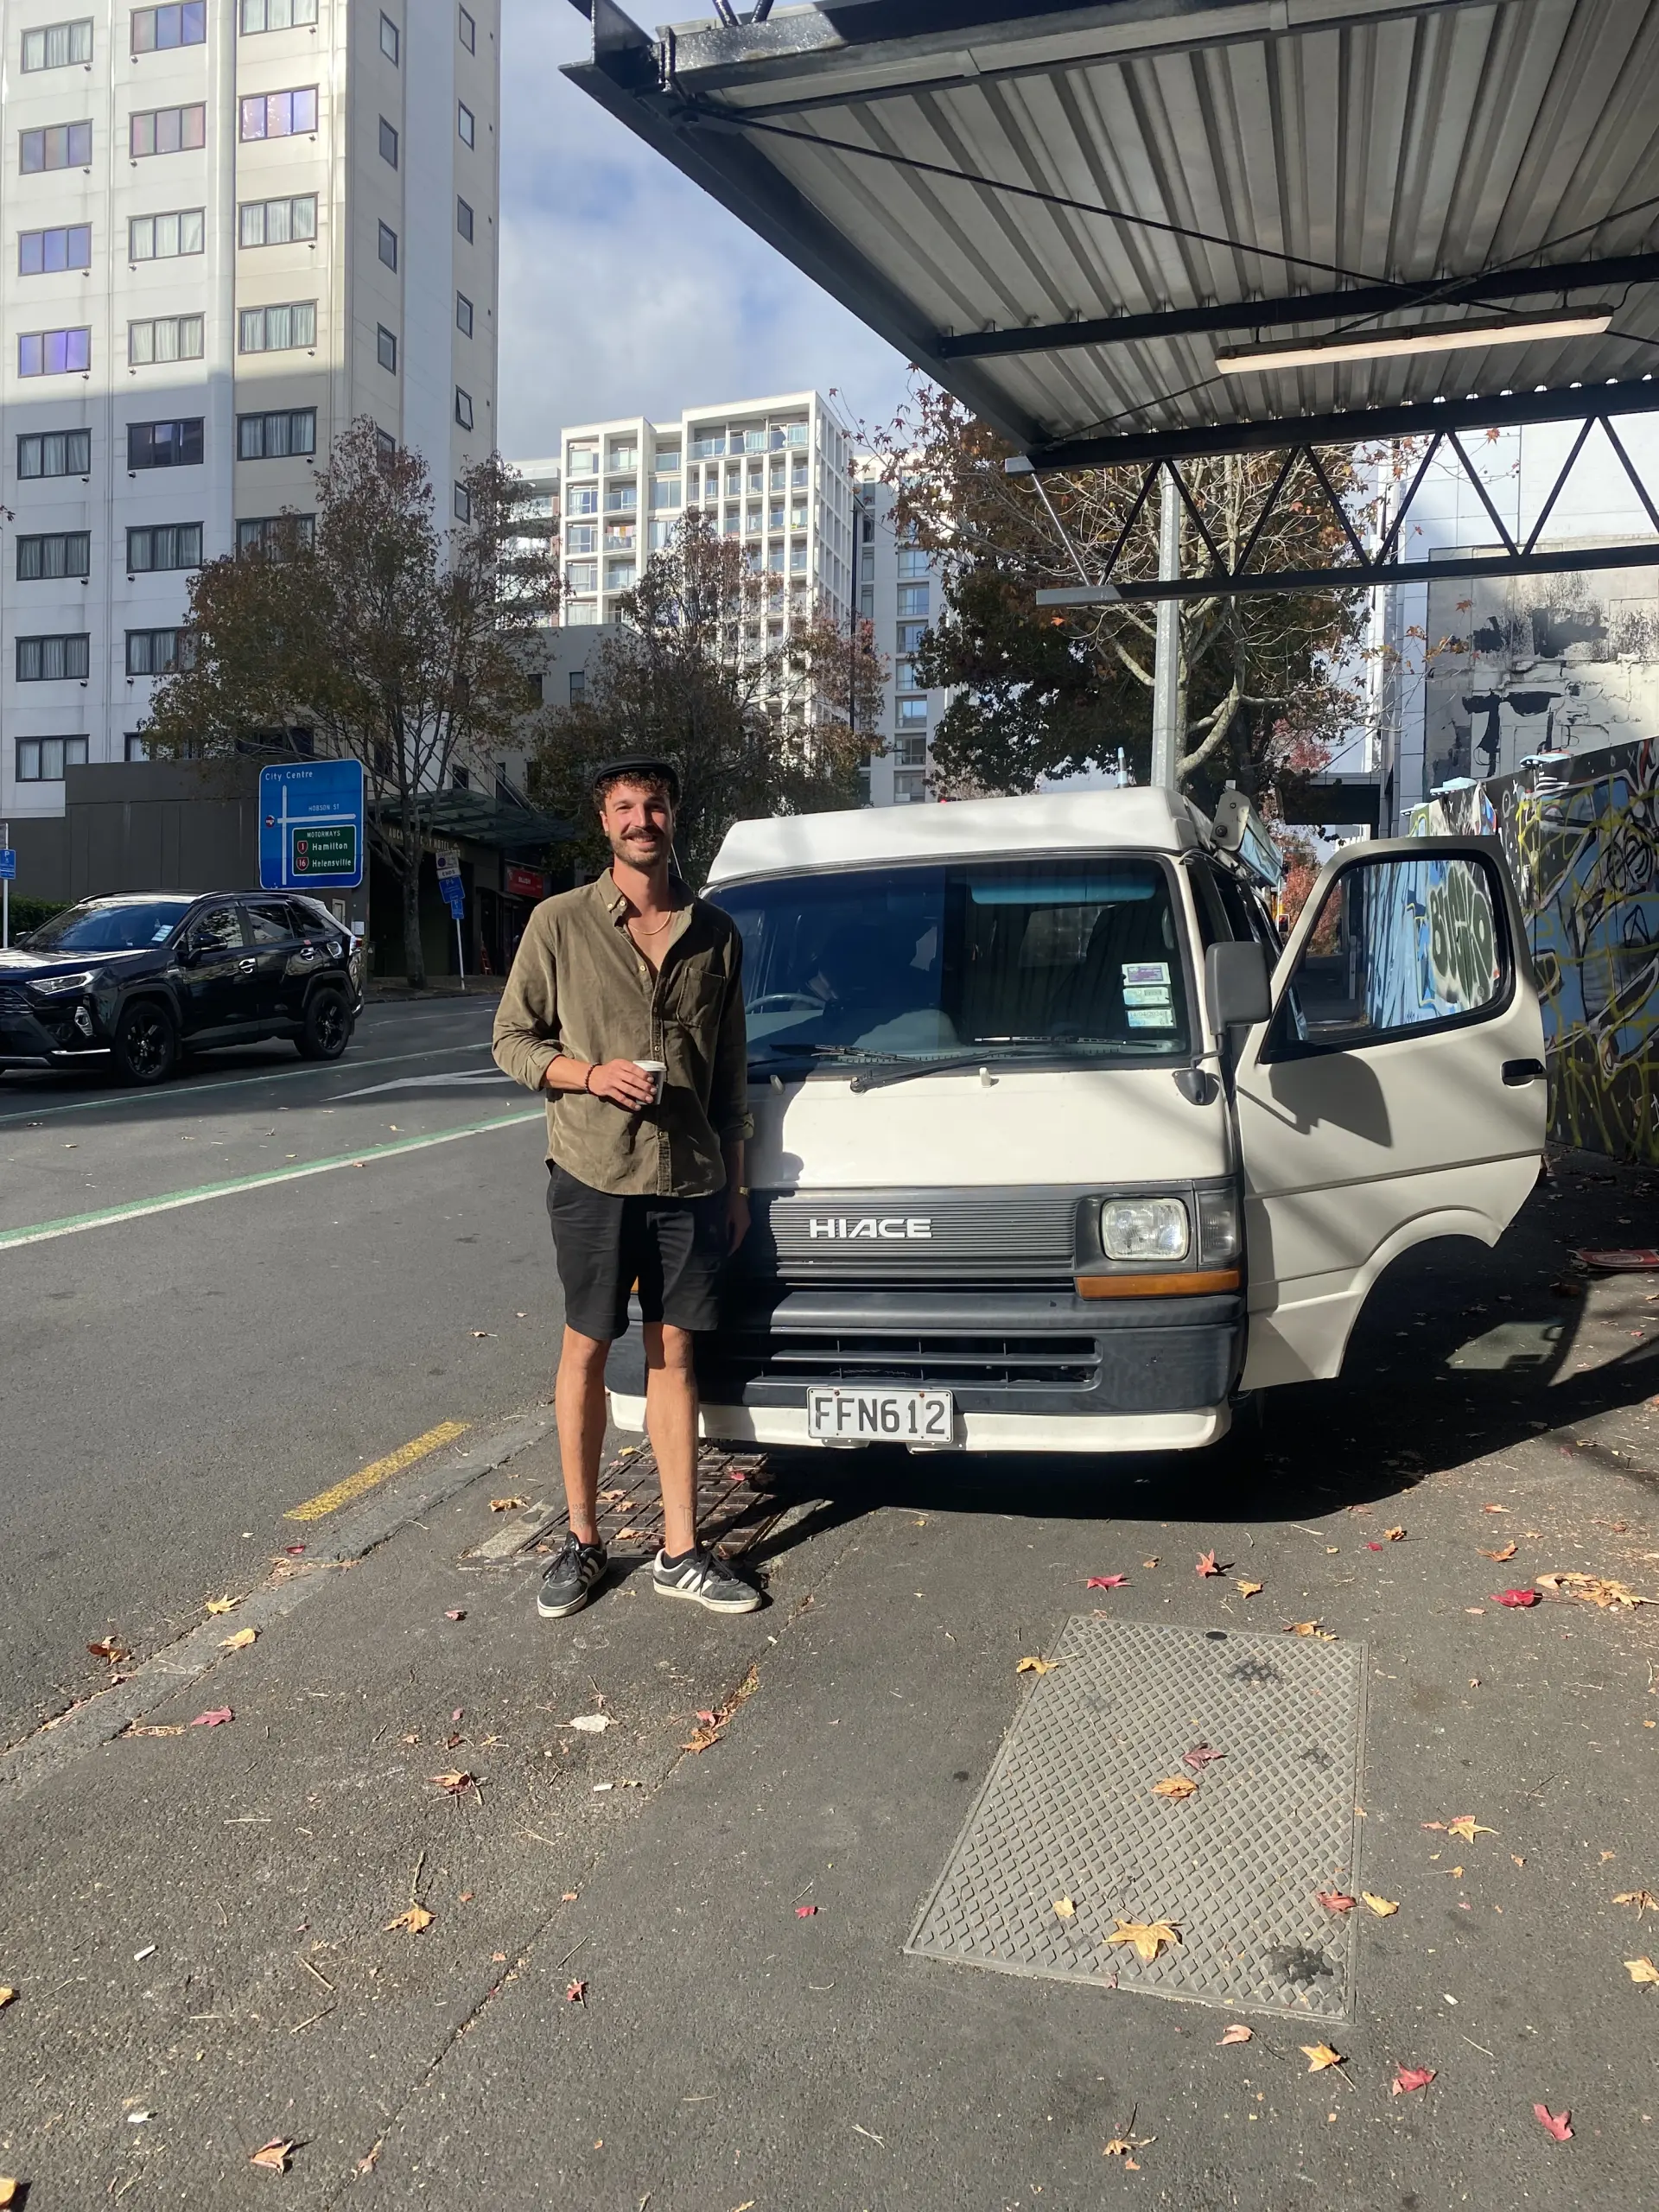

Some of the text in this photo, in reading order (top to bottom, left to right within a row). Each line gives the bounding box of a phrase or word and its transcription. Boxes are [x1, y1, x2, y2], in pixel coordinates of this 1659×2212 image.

[265, 772, 282, 781] City
[312, 858, 352, 868] Helensville
[810, 1219, 931, 1238] HIACE
[815, 1396, 945, 1434] FFN612
